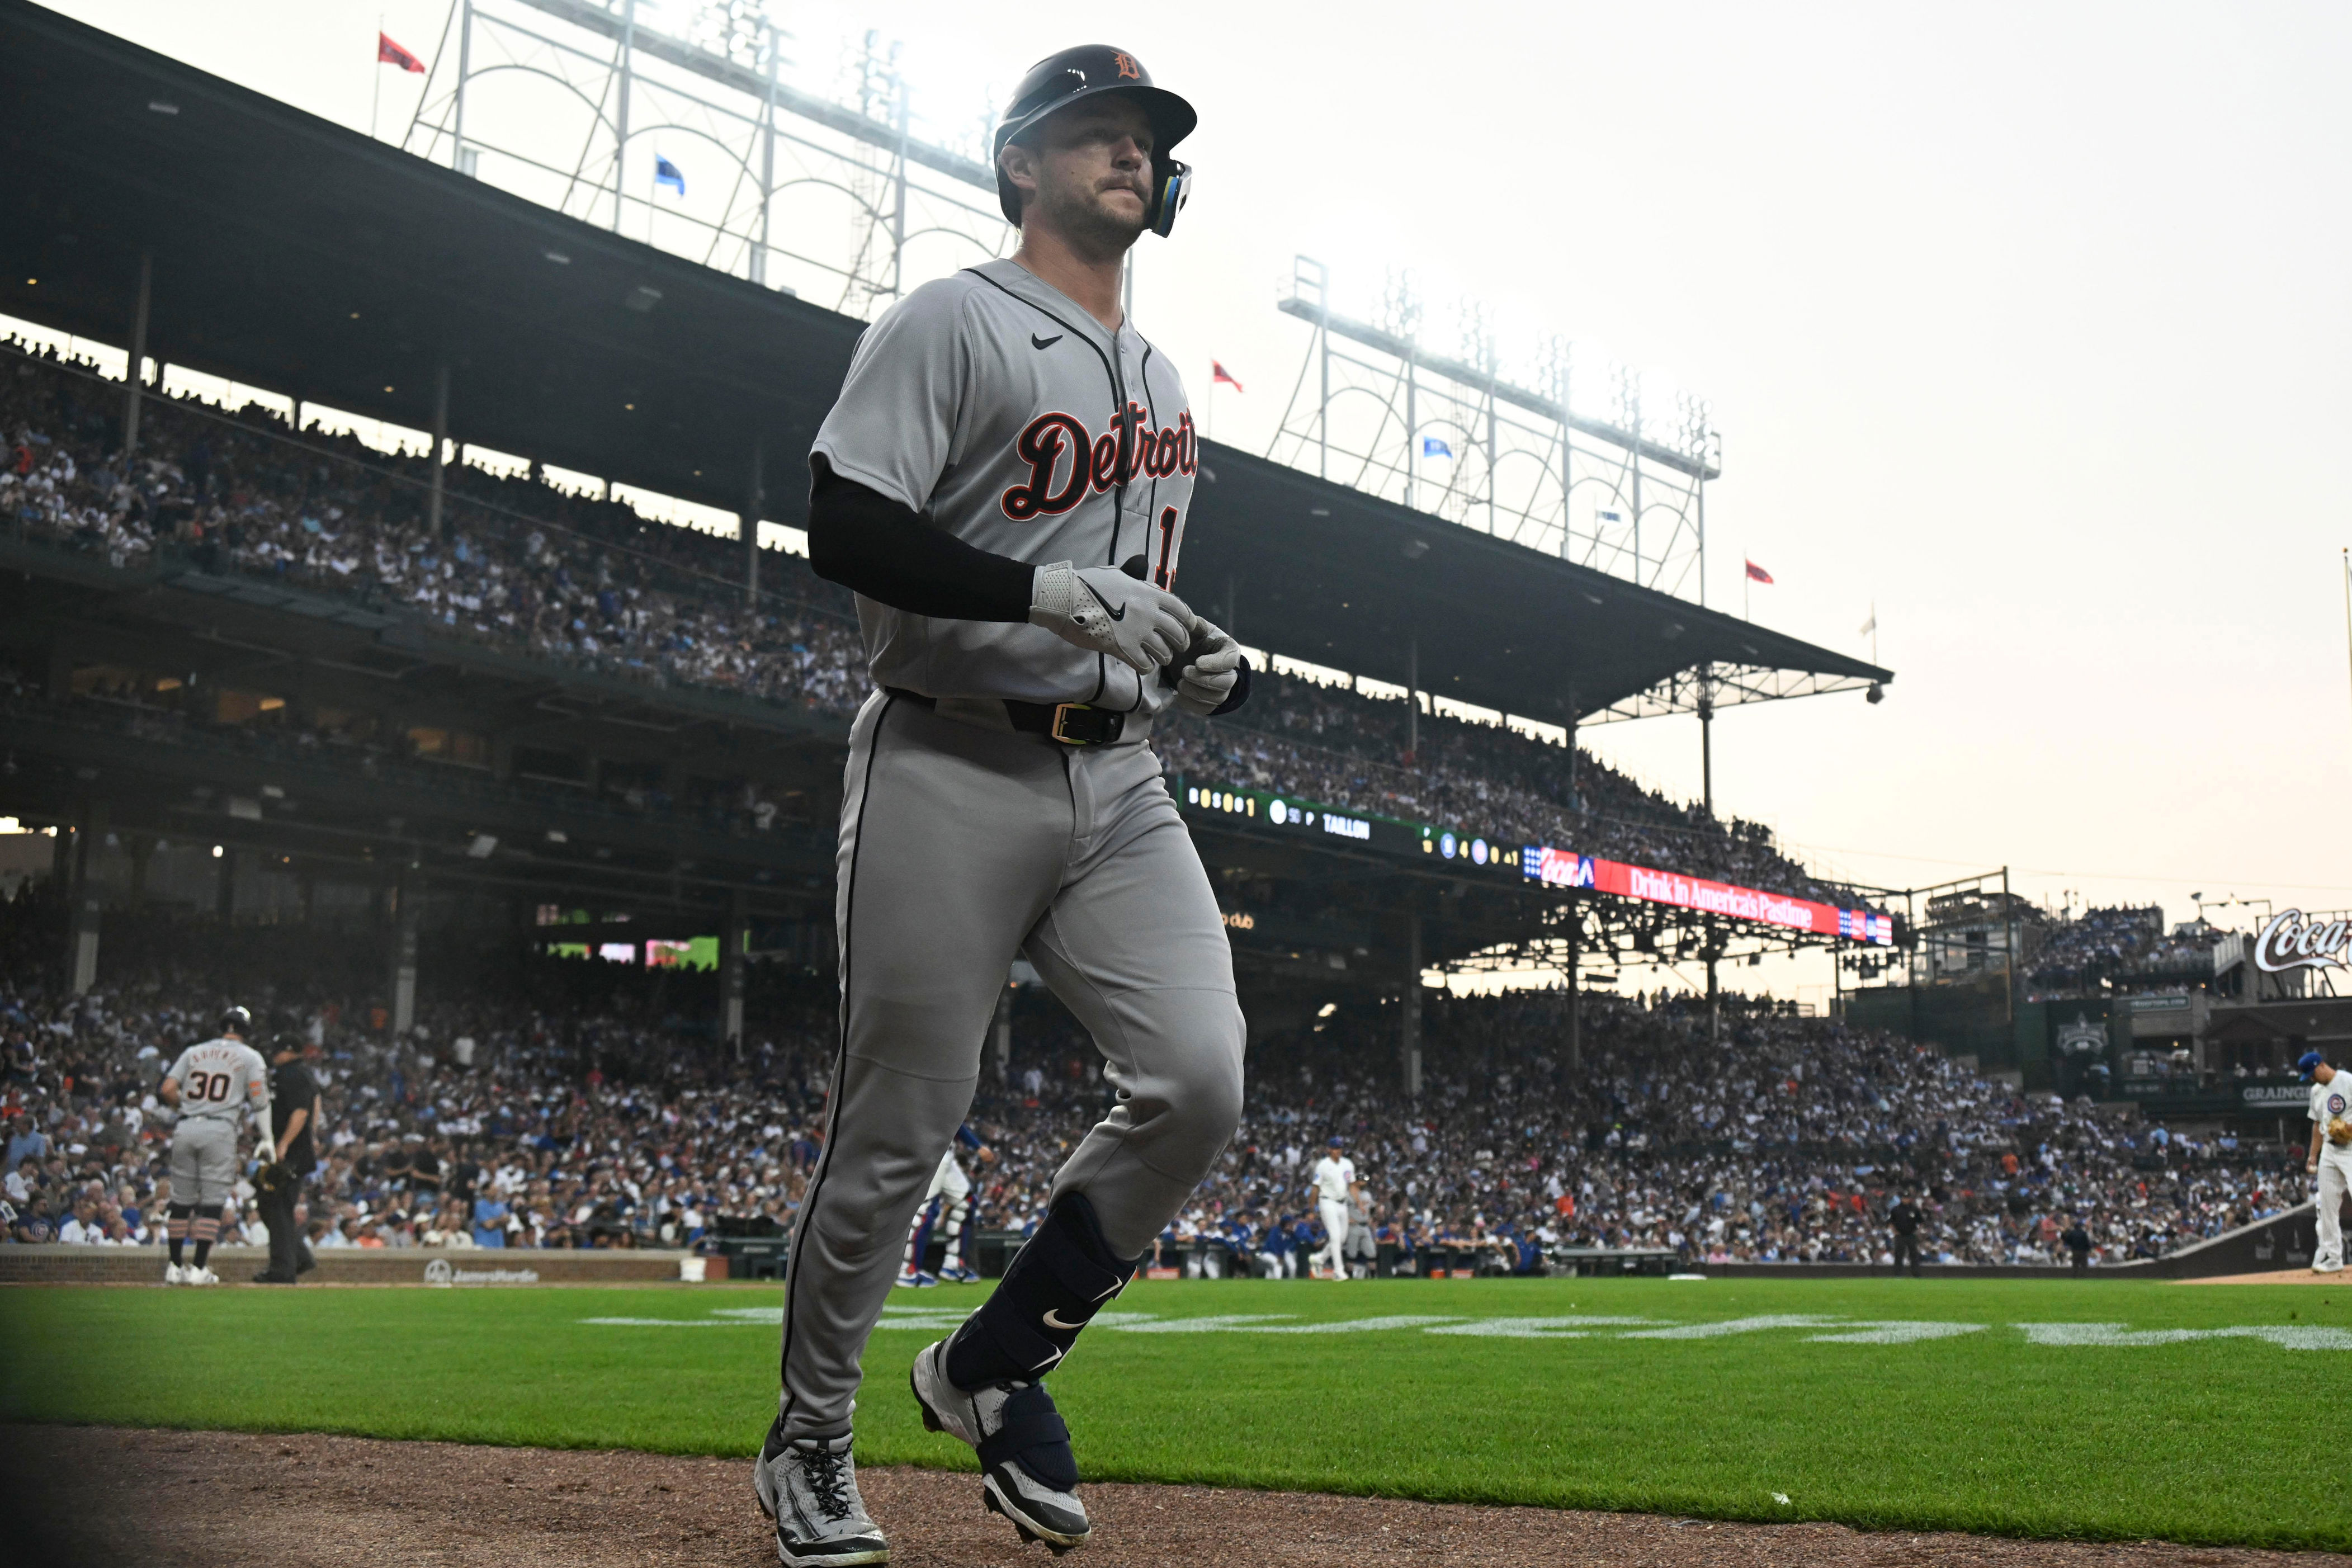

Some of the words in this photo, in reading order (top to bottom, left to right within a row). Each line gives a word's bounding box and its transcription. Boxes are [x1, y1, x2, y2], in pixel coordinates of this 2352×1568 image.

[1109, 49, 1141, 80] D
[1000, 401, 1198, 522] Detroit
[1154, 504, 1178, 594] 1
[1631, 868, 1673, 901] Drink
[1674, 876, 1689, 905] in
[1690, 881, 1758, 918] America's
[1759, 894, 1813, 928] Pastime
[2255, 909, 2352, 974] Coca
[187, 1069, 232, 1103] 30
